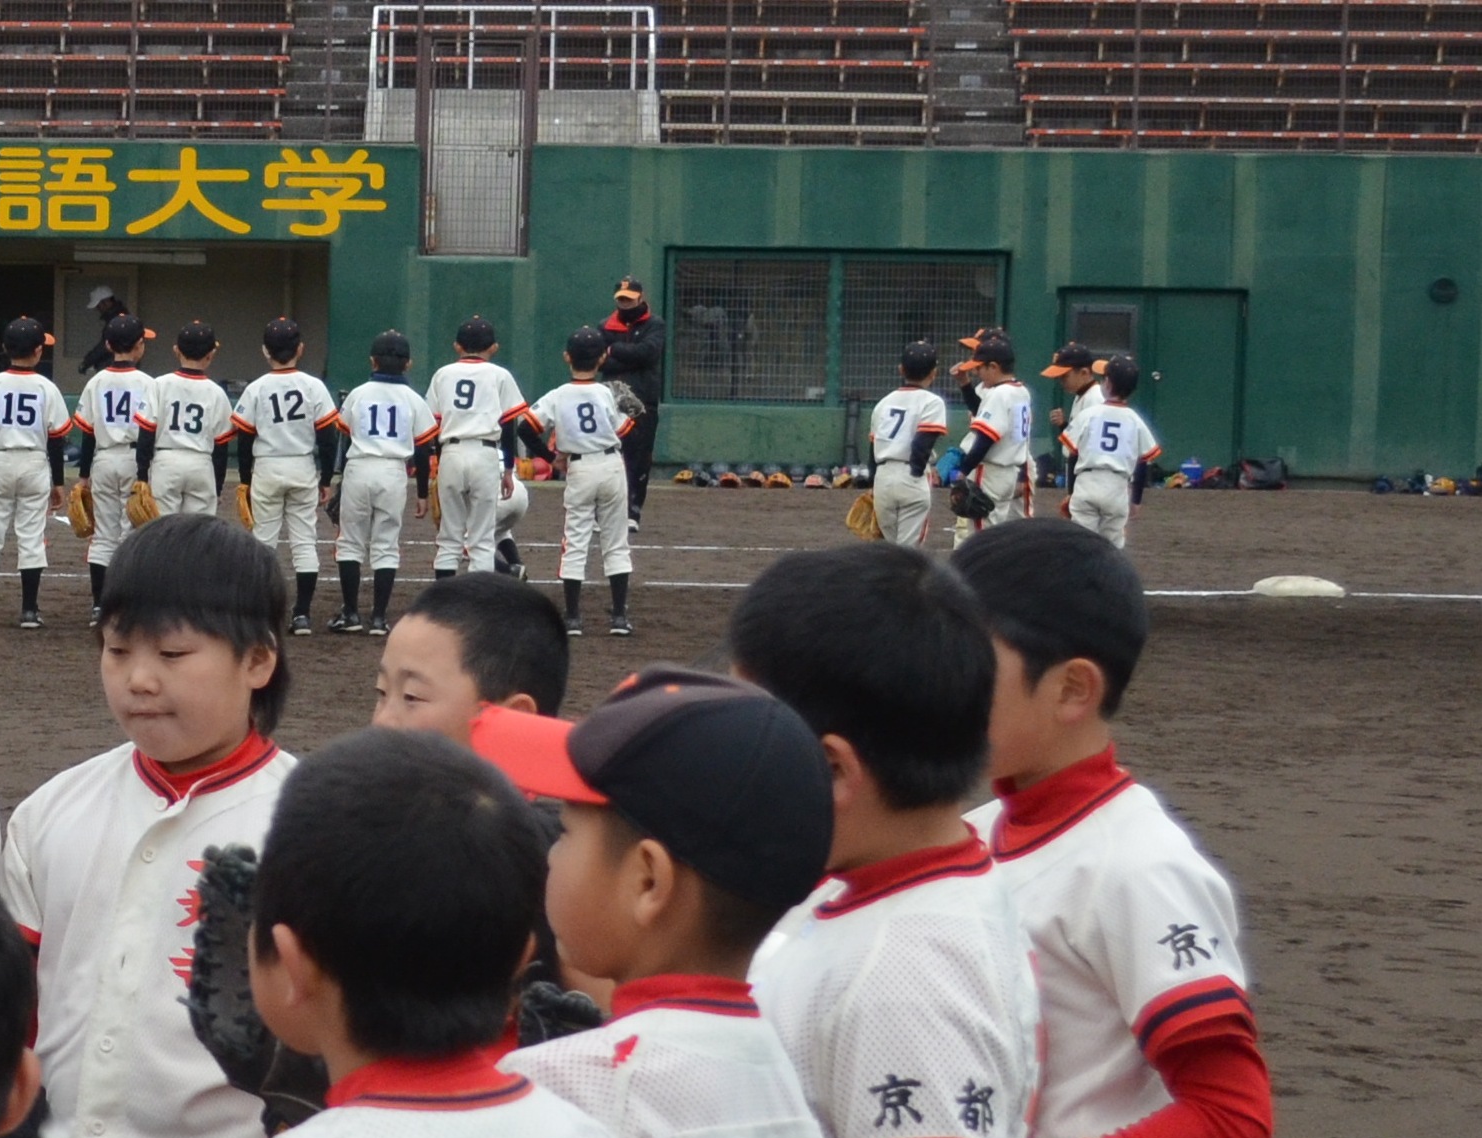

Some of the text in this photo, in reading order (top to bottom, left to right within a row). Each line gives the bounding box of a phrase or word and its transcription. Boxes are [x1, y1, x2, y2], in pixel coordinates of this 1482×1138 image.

[2, 392, 38, 427] 15
[103, 390, 132, 423] 14
[269, 389, 306, 424] 12
[453, 379, 476, 410] 9
[168, 400, 205, 434] 13
[367, 404, 399, 438] 11
[576, 402, 598, 434] 8
[889, 408, 907, 439] 7
[1100, 422, 1121, 452] 5
[1157, 923, 1220, 970] 京
[868, 1073, 996, 1134] 京都
